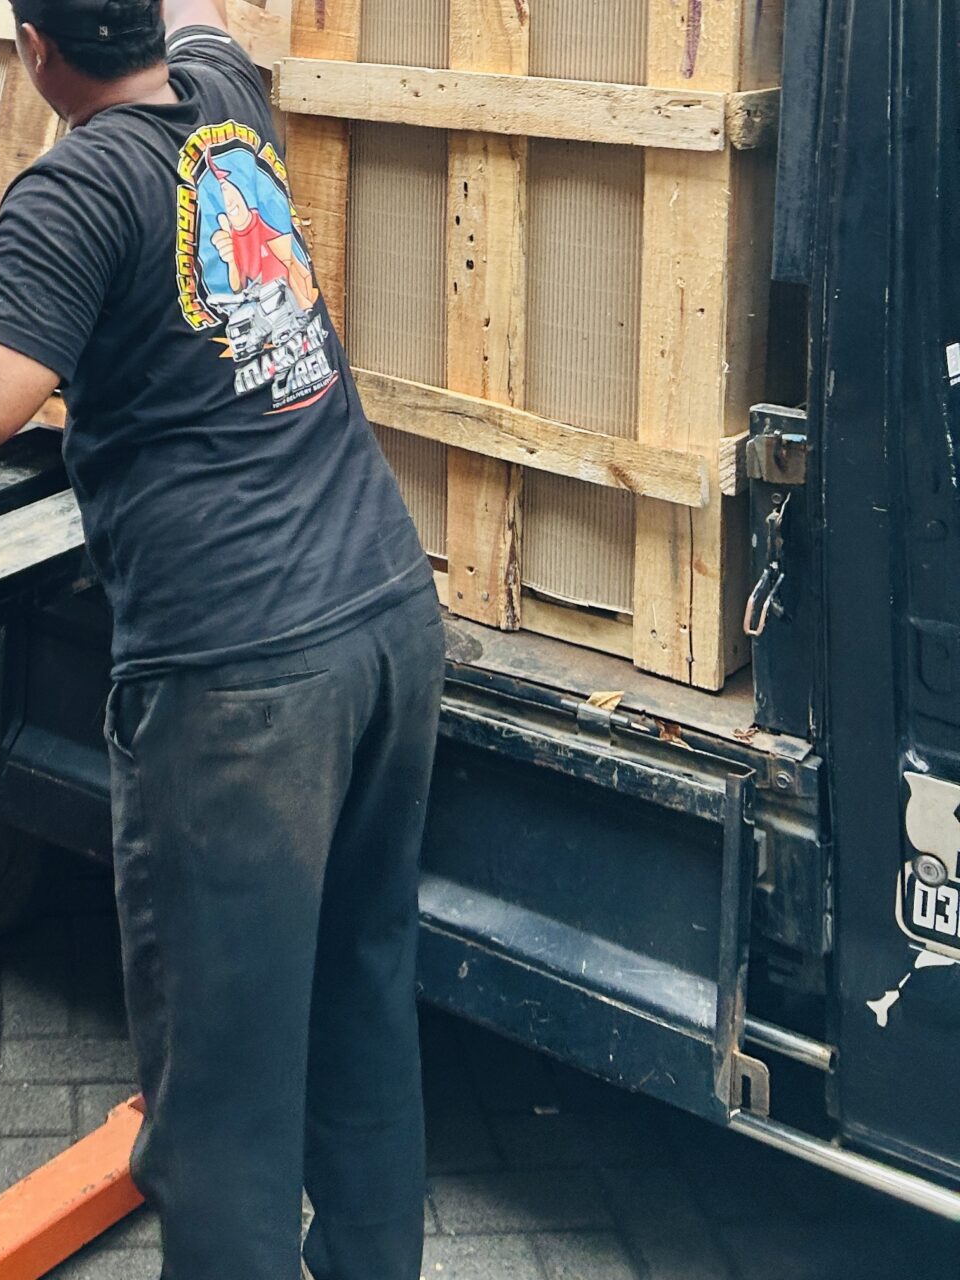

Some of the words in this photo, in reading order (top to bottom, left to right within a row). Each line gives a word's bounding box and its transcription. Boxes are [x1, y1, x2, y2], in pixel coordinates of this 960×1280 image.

[176, 183, 222, 332] JAGONYA
[271, 347, 333, 401] CARGO
[913, 879, 960, 938] 03
